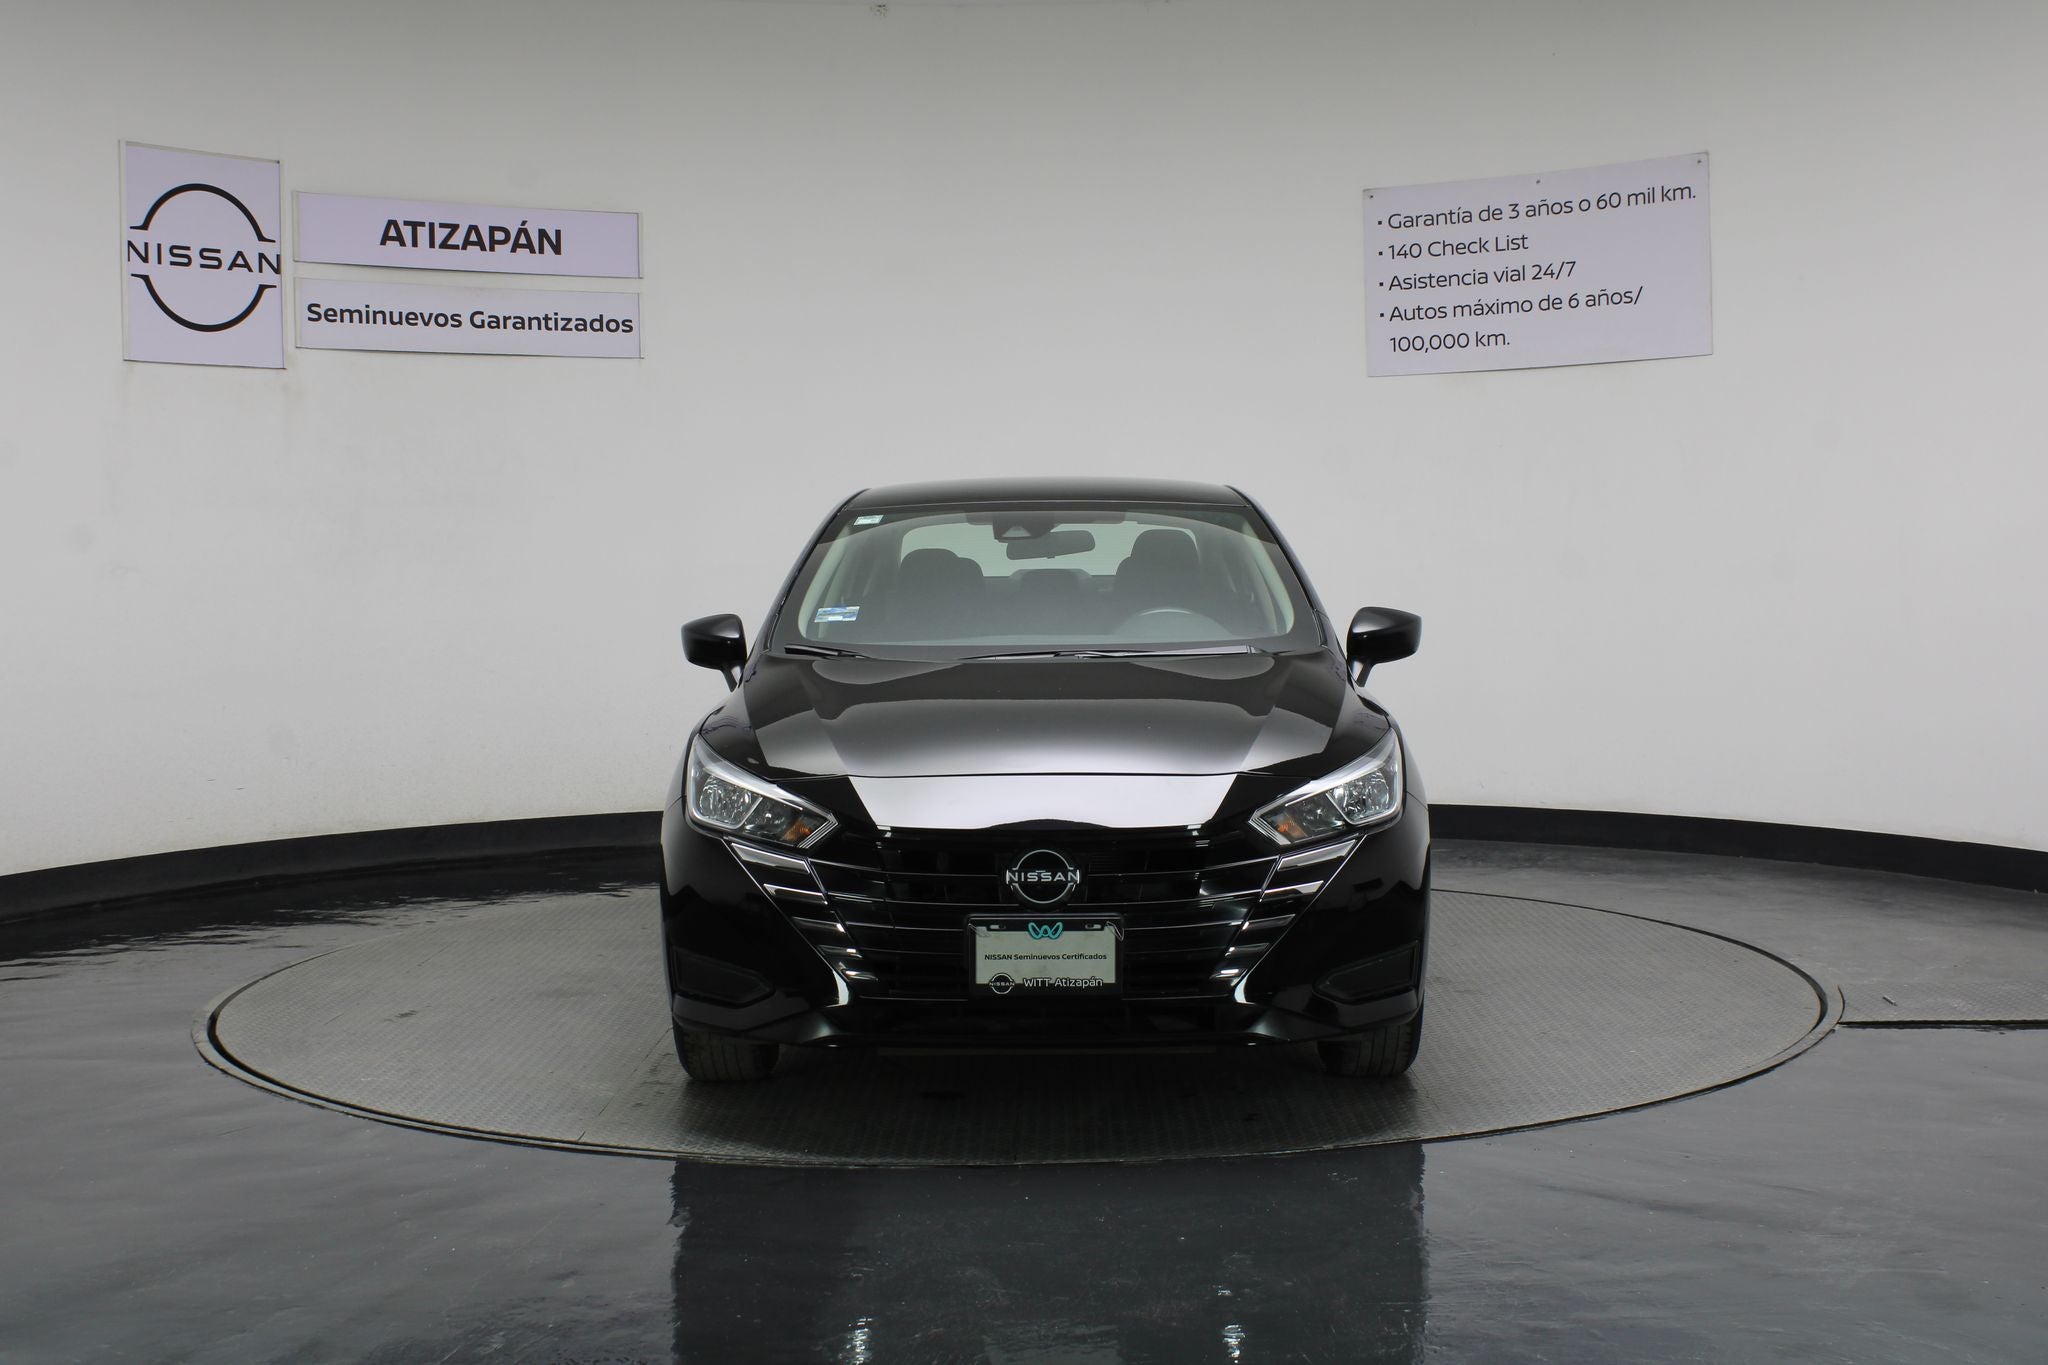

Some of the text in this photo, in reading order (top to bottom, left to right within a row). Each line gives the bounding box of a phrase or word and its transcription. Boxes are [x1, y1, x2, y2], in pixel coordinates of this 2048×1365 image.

[1387, 184, 1697, 230] Garantía de 3 años o 60 mil km.
[379, 218, 562, 256] ATIZAPÁN
[1387, 234, 1529, 260] 140 Check List
[127, 239, 282, 276] NISSAN
[1388, 260, 1577, 292] Asistencia vial 24/7
[306, 302, 634, 334] Seminuevos Garantizados
[1389, 285, 1644, 322] Autos máximo de 6 años/
[1389, 331, 1511, 354] 100,000 km.
[1007, 871, 1079, 882] NISSAN
[984, 953, 1012, 961] NISSAN
[1014, 953, 1060, 961] Seminuevos
[1023, 976, 1103, 989] WITT Atizapán
